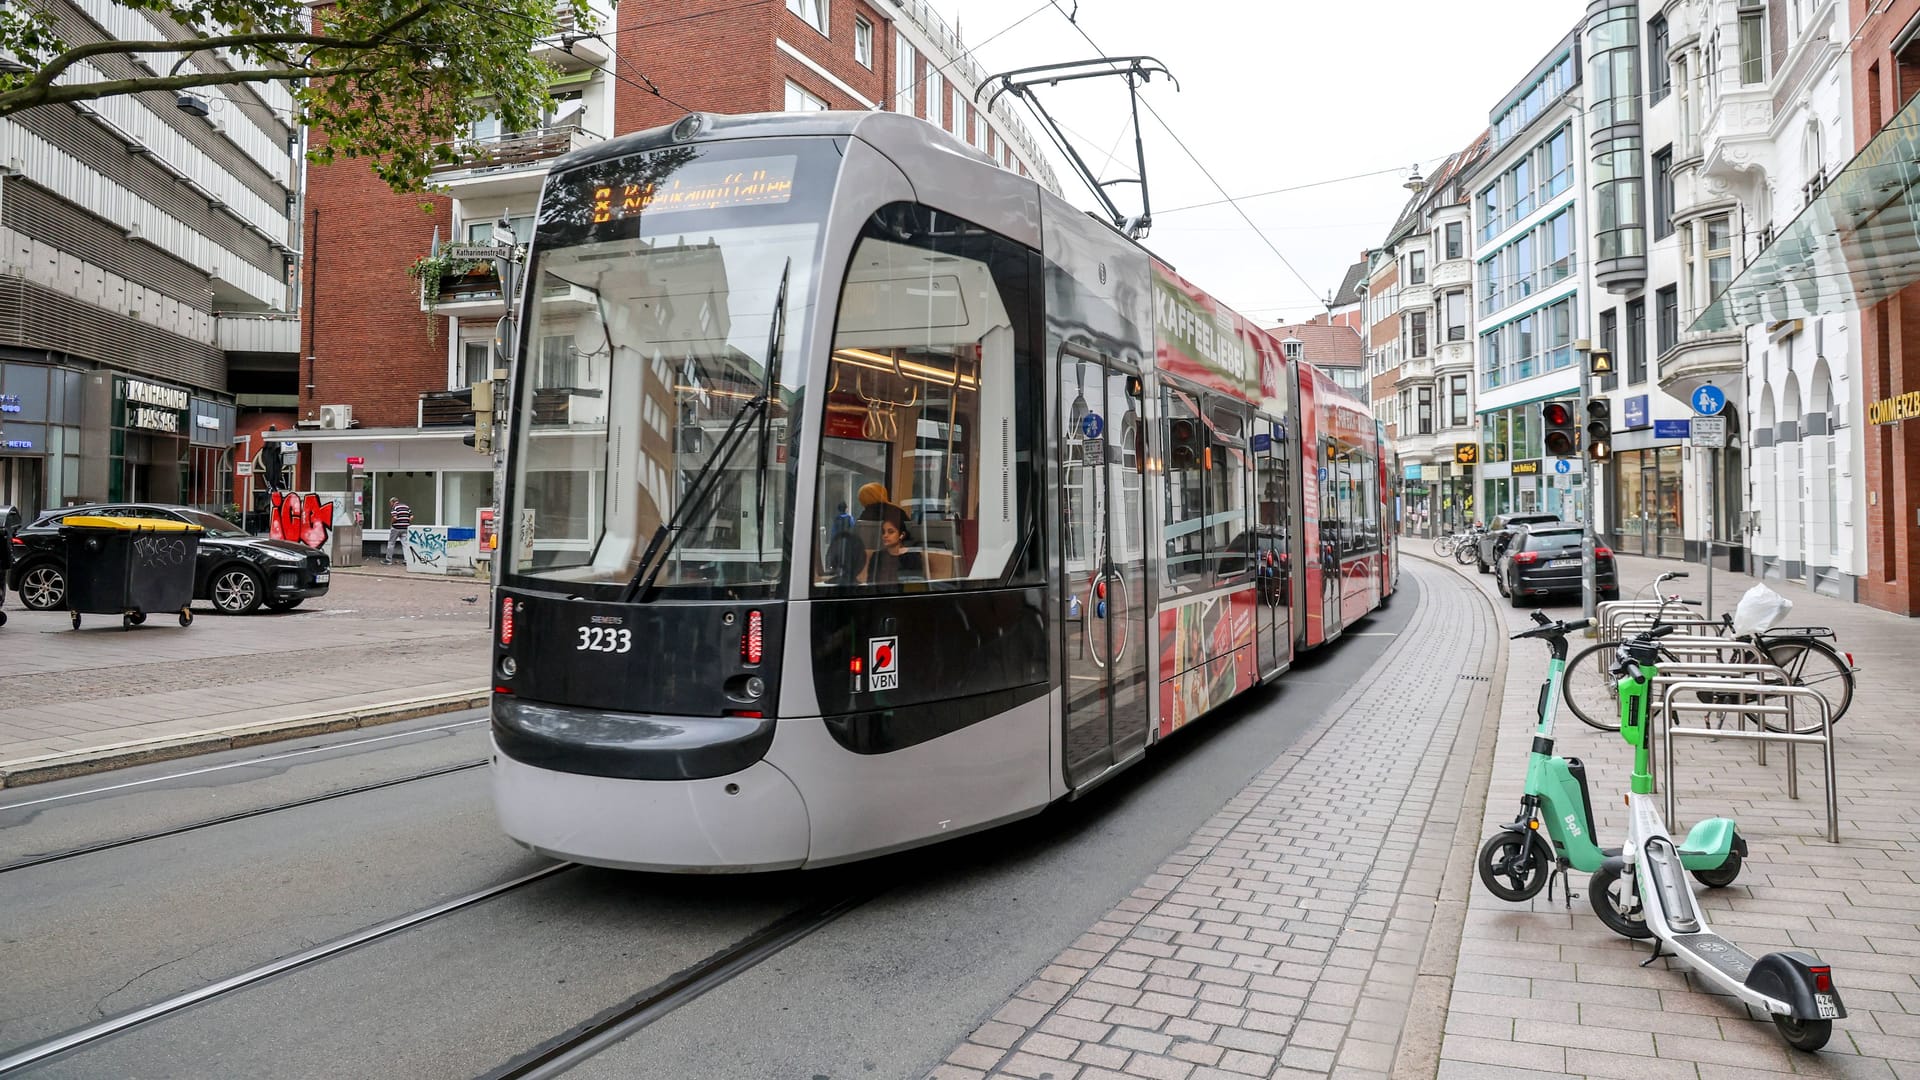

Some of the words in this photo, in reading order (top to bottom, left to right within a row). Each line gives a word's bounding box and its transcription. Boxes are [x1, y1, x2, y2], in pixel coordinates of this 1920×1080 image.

[456, 249, 506, 257] Katharinenstraße
[1156, 287, 1244, 381] KAFFEELIEBE!
[133, 380, 188, 410] KATHARINEN
[591, 615, 623, 624] SIEMENS
[576, 626, 632, 653] 3233
[871, 674, 896, 689] VBN
[1564, 814, 1581, 837] Bolt
